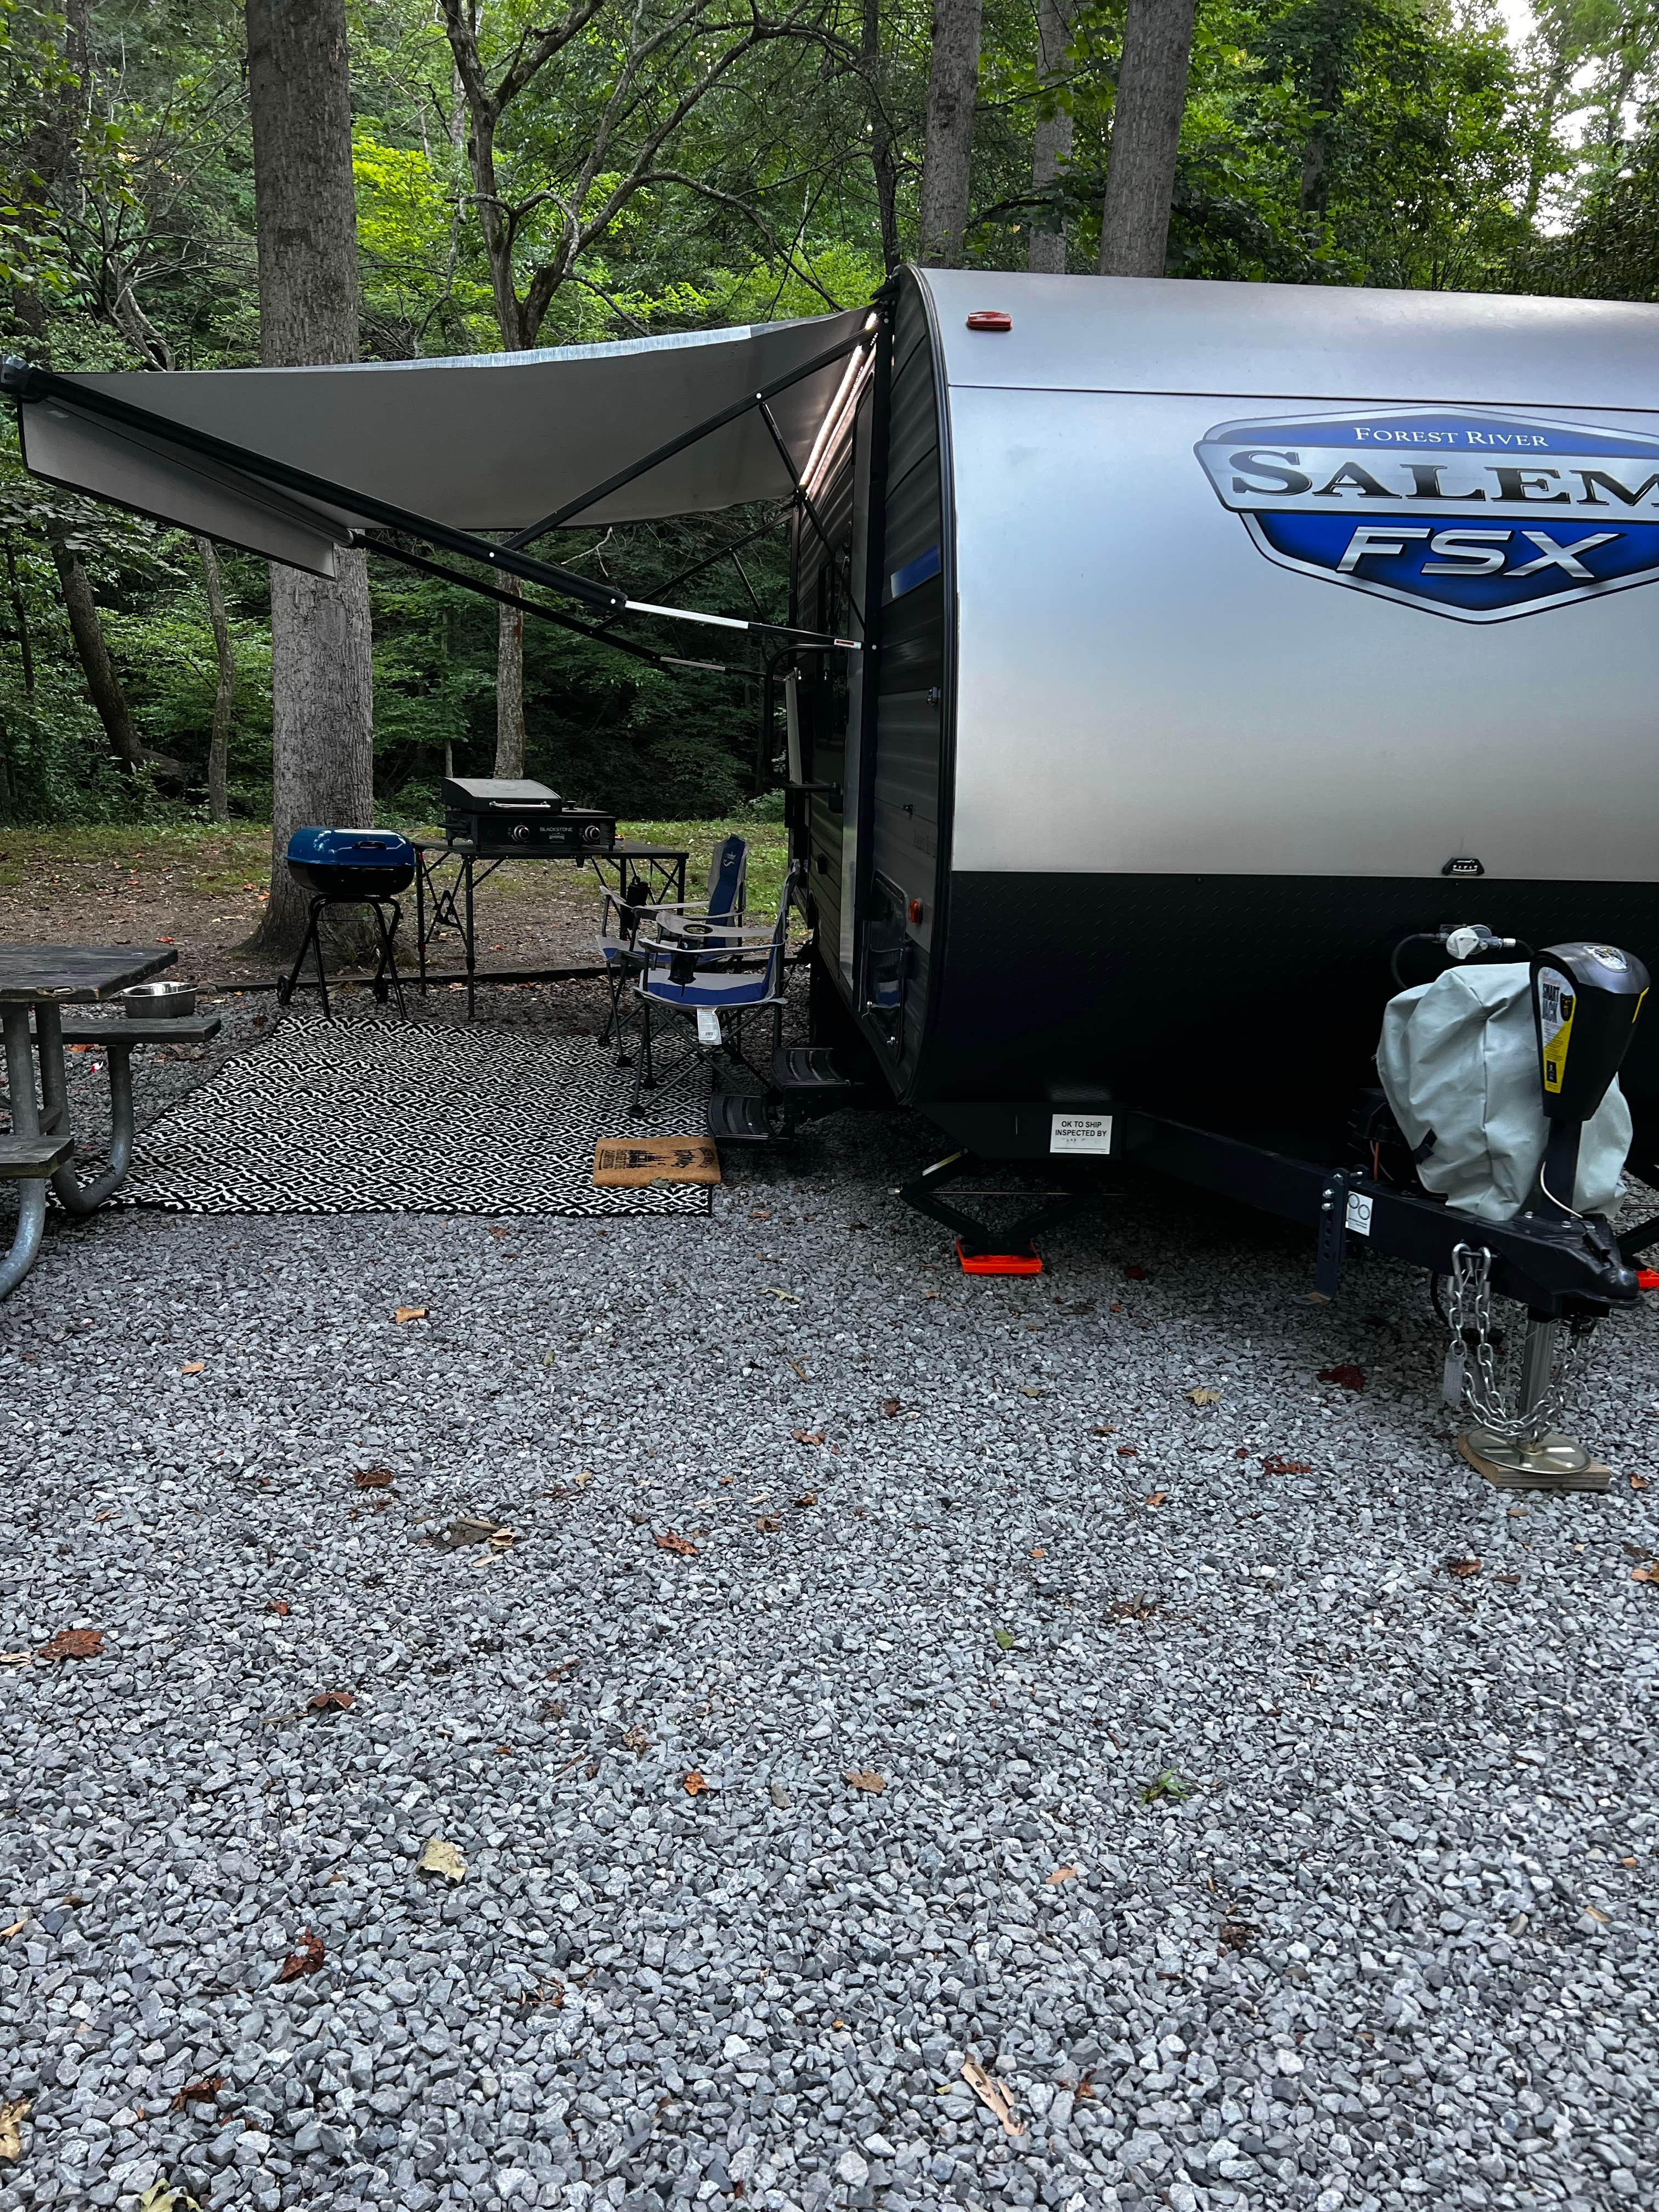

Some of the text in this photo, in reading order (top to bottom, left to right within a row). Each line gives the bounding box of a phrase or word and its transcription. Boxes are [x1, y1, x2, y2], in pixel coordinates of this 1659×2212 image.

[1353, 427, 1549, 447] FOREST RIVER
[1228, 450, 1659, 506] SALEM
[1336, 526, 1620, 578] FSX
